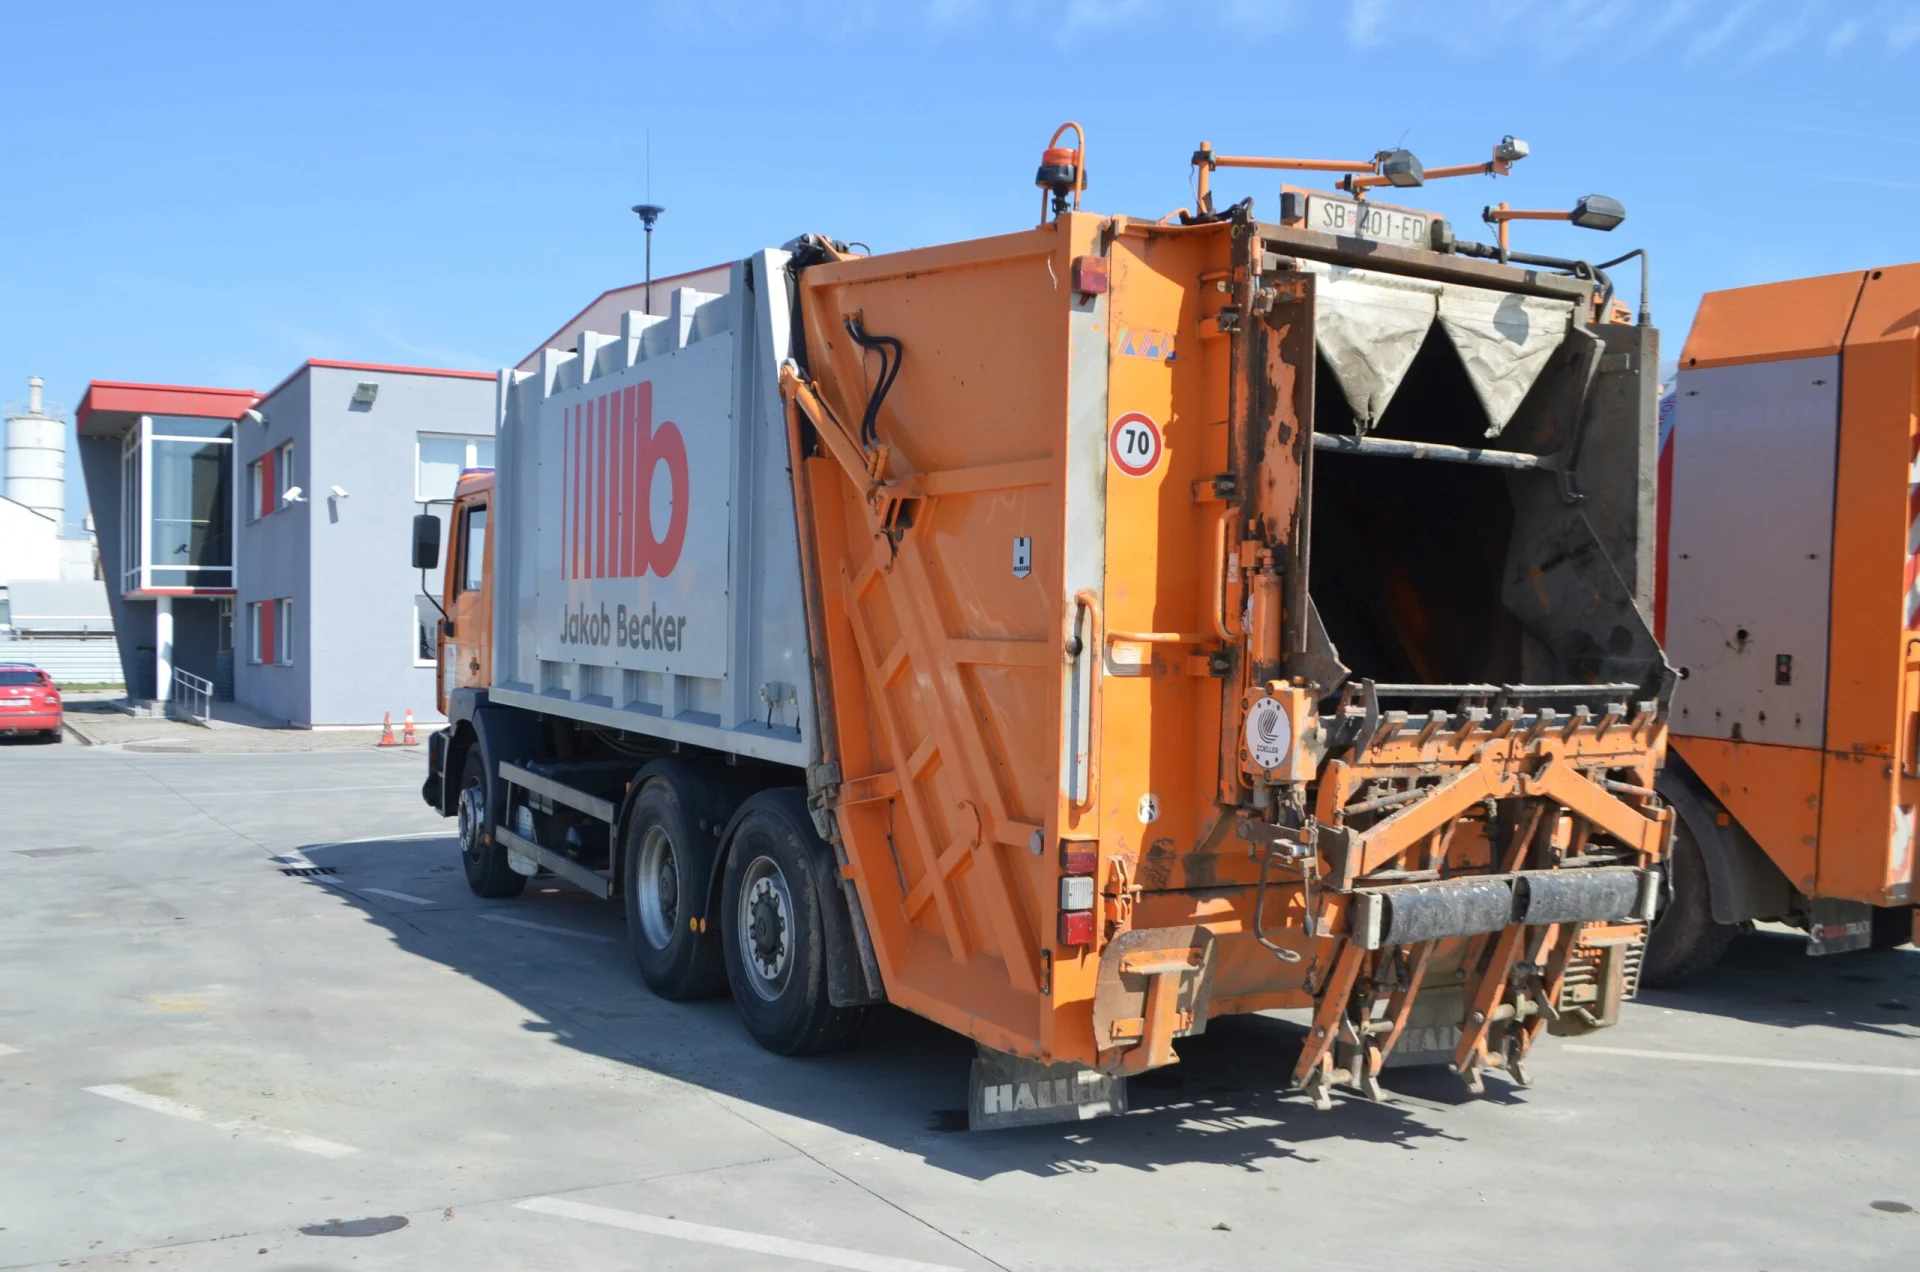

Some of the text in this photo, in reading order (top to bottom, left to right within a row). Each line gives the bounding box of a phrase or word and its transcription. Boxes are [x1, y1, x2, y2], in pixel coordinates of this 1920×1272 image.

[1323, 202, 1345, 228] SB
[1125, 429, 1150, 455] 70
[560, 601, 686, 652] Jakob Becker
[1256, 744, 1279, 754] ZOELLER
